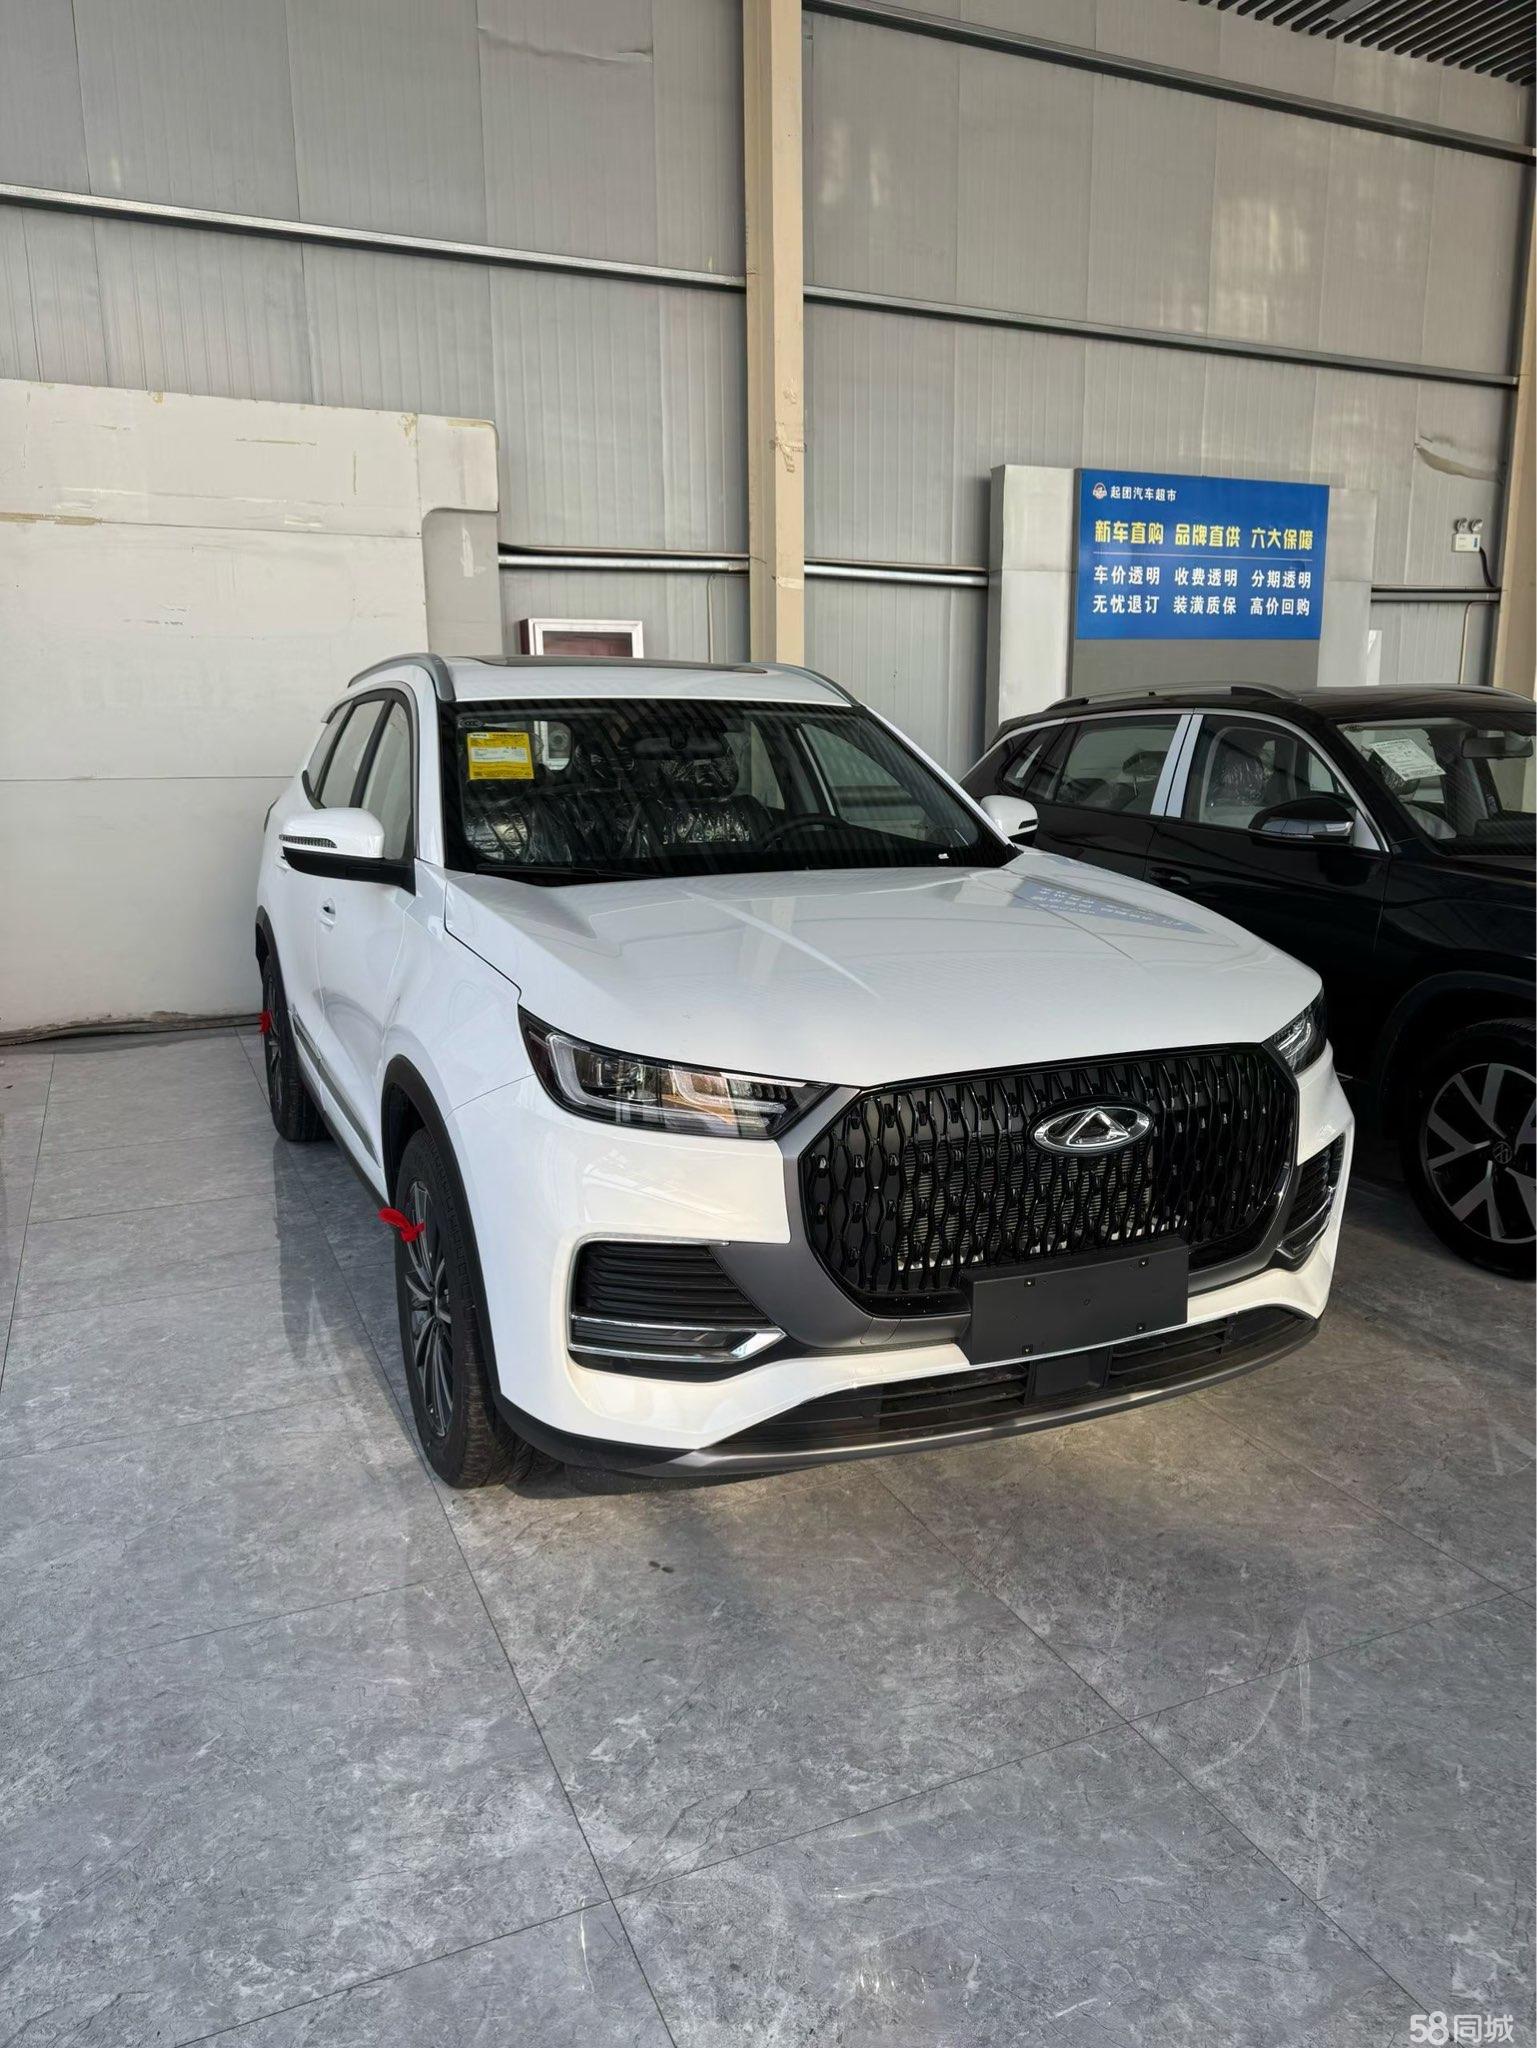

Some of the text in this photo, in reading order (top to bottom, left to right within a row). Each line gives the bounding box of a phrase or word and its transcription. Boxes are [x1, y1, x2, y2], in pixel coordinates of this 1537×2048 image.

[1110, 485, 1177, 501] 起团汽车超市
[1094, 520, 1313, 550] 新车直购 品牌直供 六大保障
[1093, 565, 1311, 589] 车价透明 收费透明 分期透明
[1093, 595, 1310, 616] 无忧退订 装潢质保 高价回购
